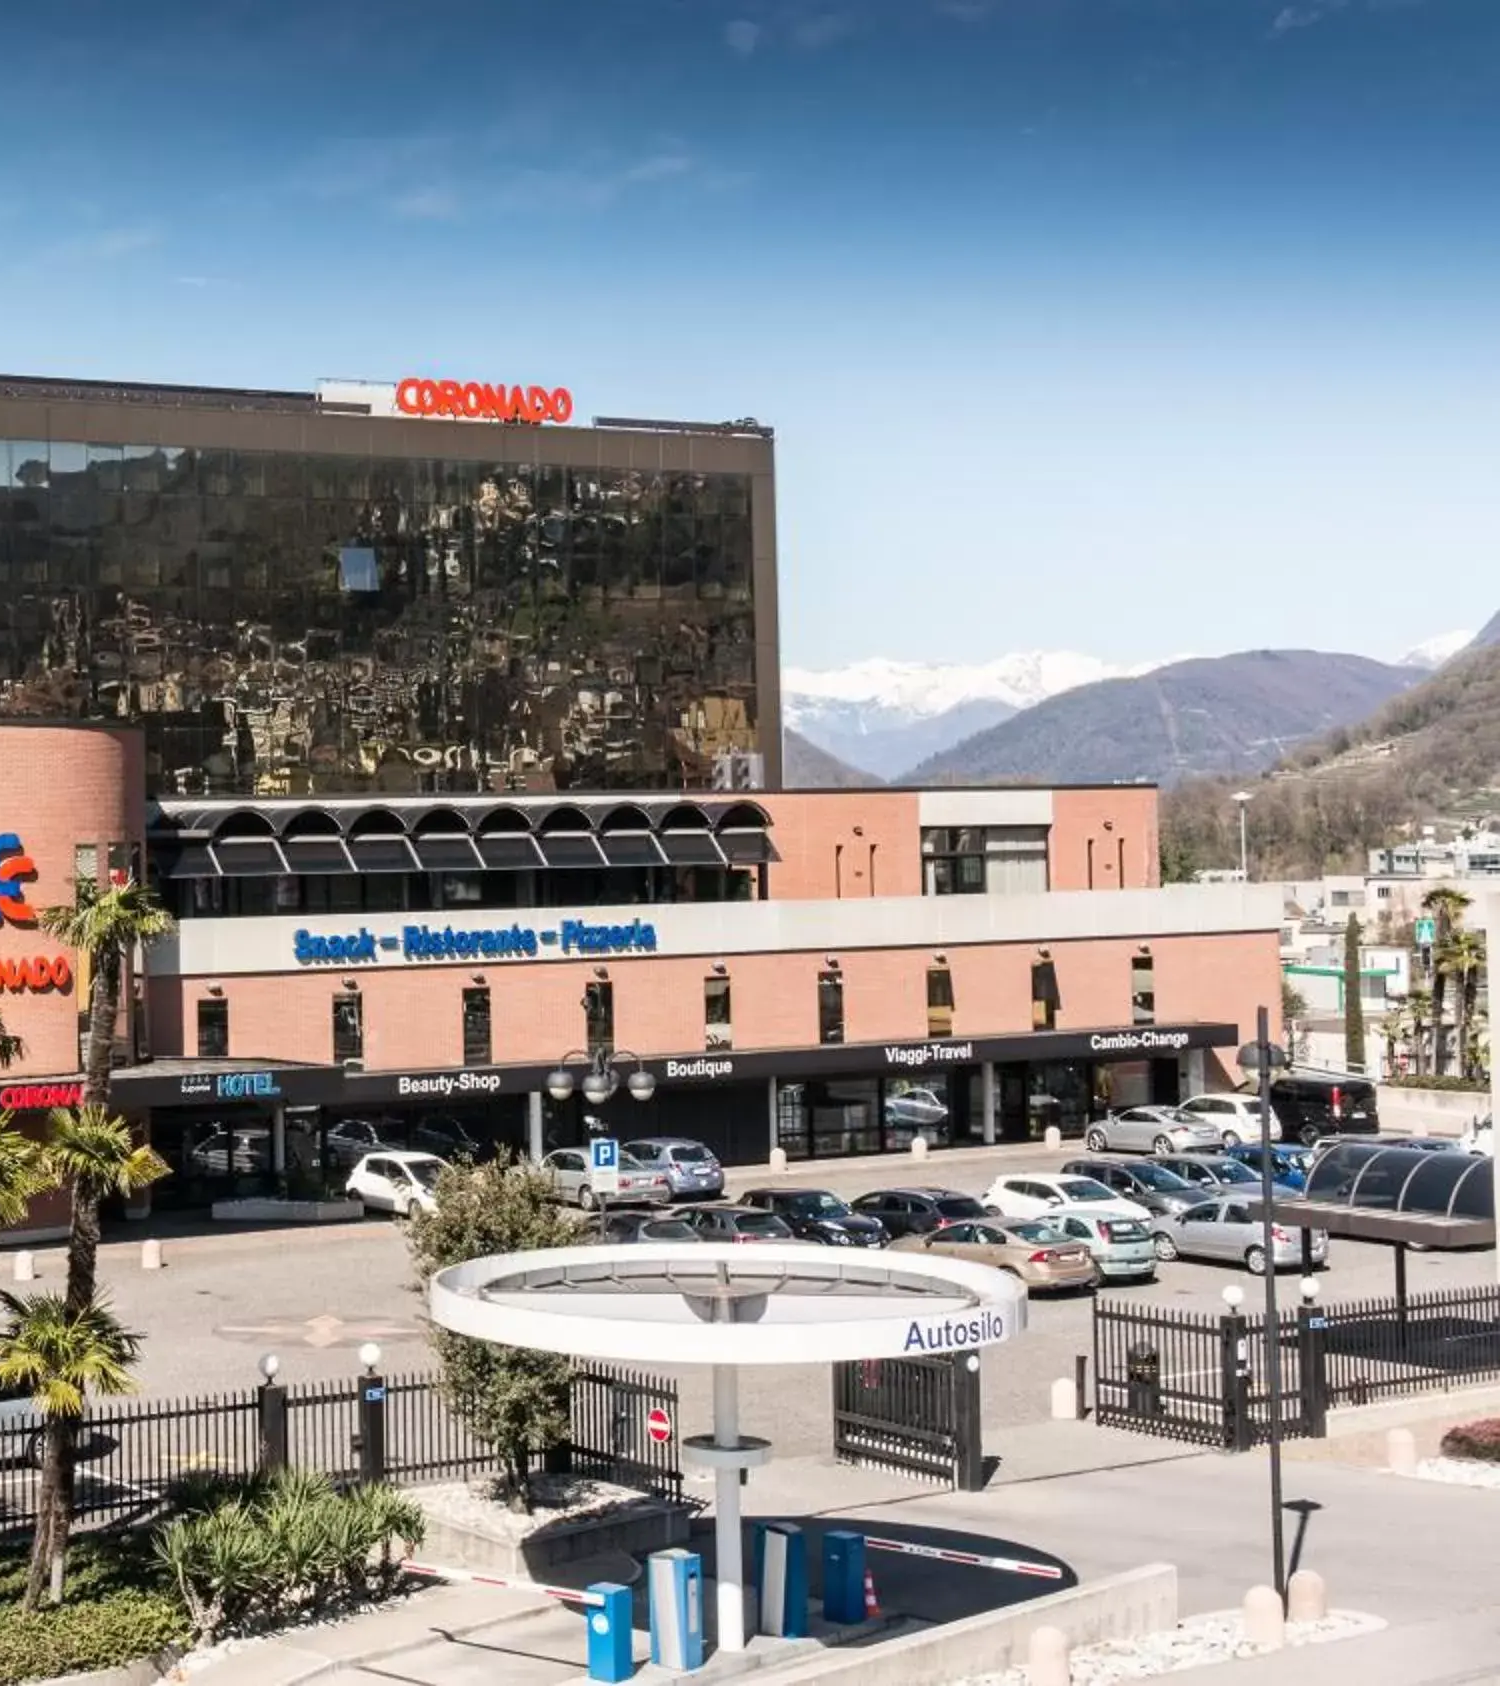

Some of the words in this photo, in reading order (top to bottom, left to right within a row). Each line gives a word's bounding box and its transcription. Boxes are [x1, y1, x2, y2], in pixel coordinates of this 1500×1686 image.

[397, 378, 573, 424] CORONADO
[295, 927, 376, 964] Snack
[404, 924, 537, 959] Ristorante
[561, 918, 657, 953] Pizzeria
[1091, 1031, 1189, 1051] Cambio-Change
[884, 1042, 973, 1065] Viaggi-Travel
[667, 1059, 733, 1078] Boutique
[0, 1083, 85, 1109] CORONA
[217, 1072, 281, 1097] HOTEL
[399, 1073, 501, 1095] Beauty-Shop
[599, 1145, 611, 1165] P
[904, 1311, 1003, 1352] Autosilo
